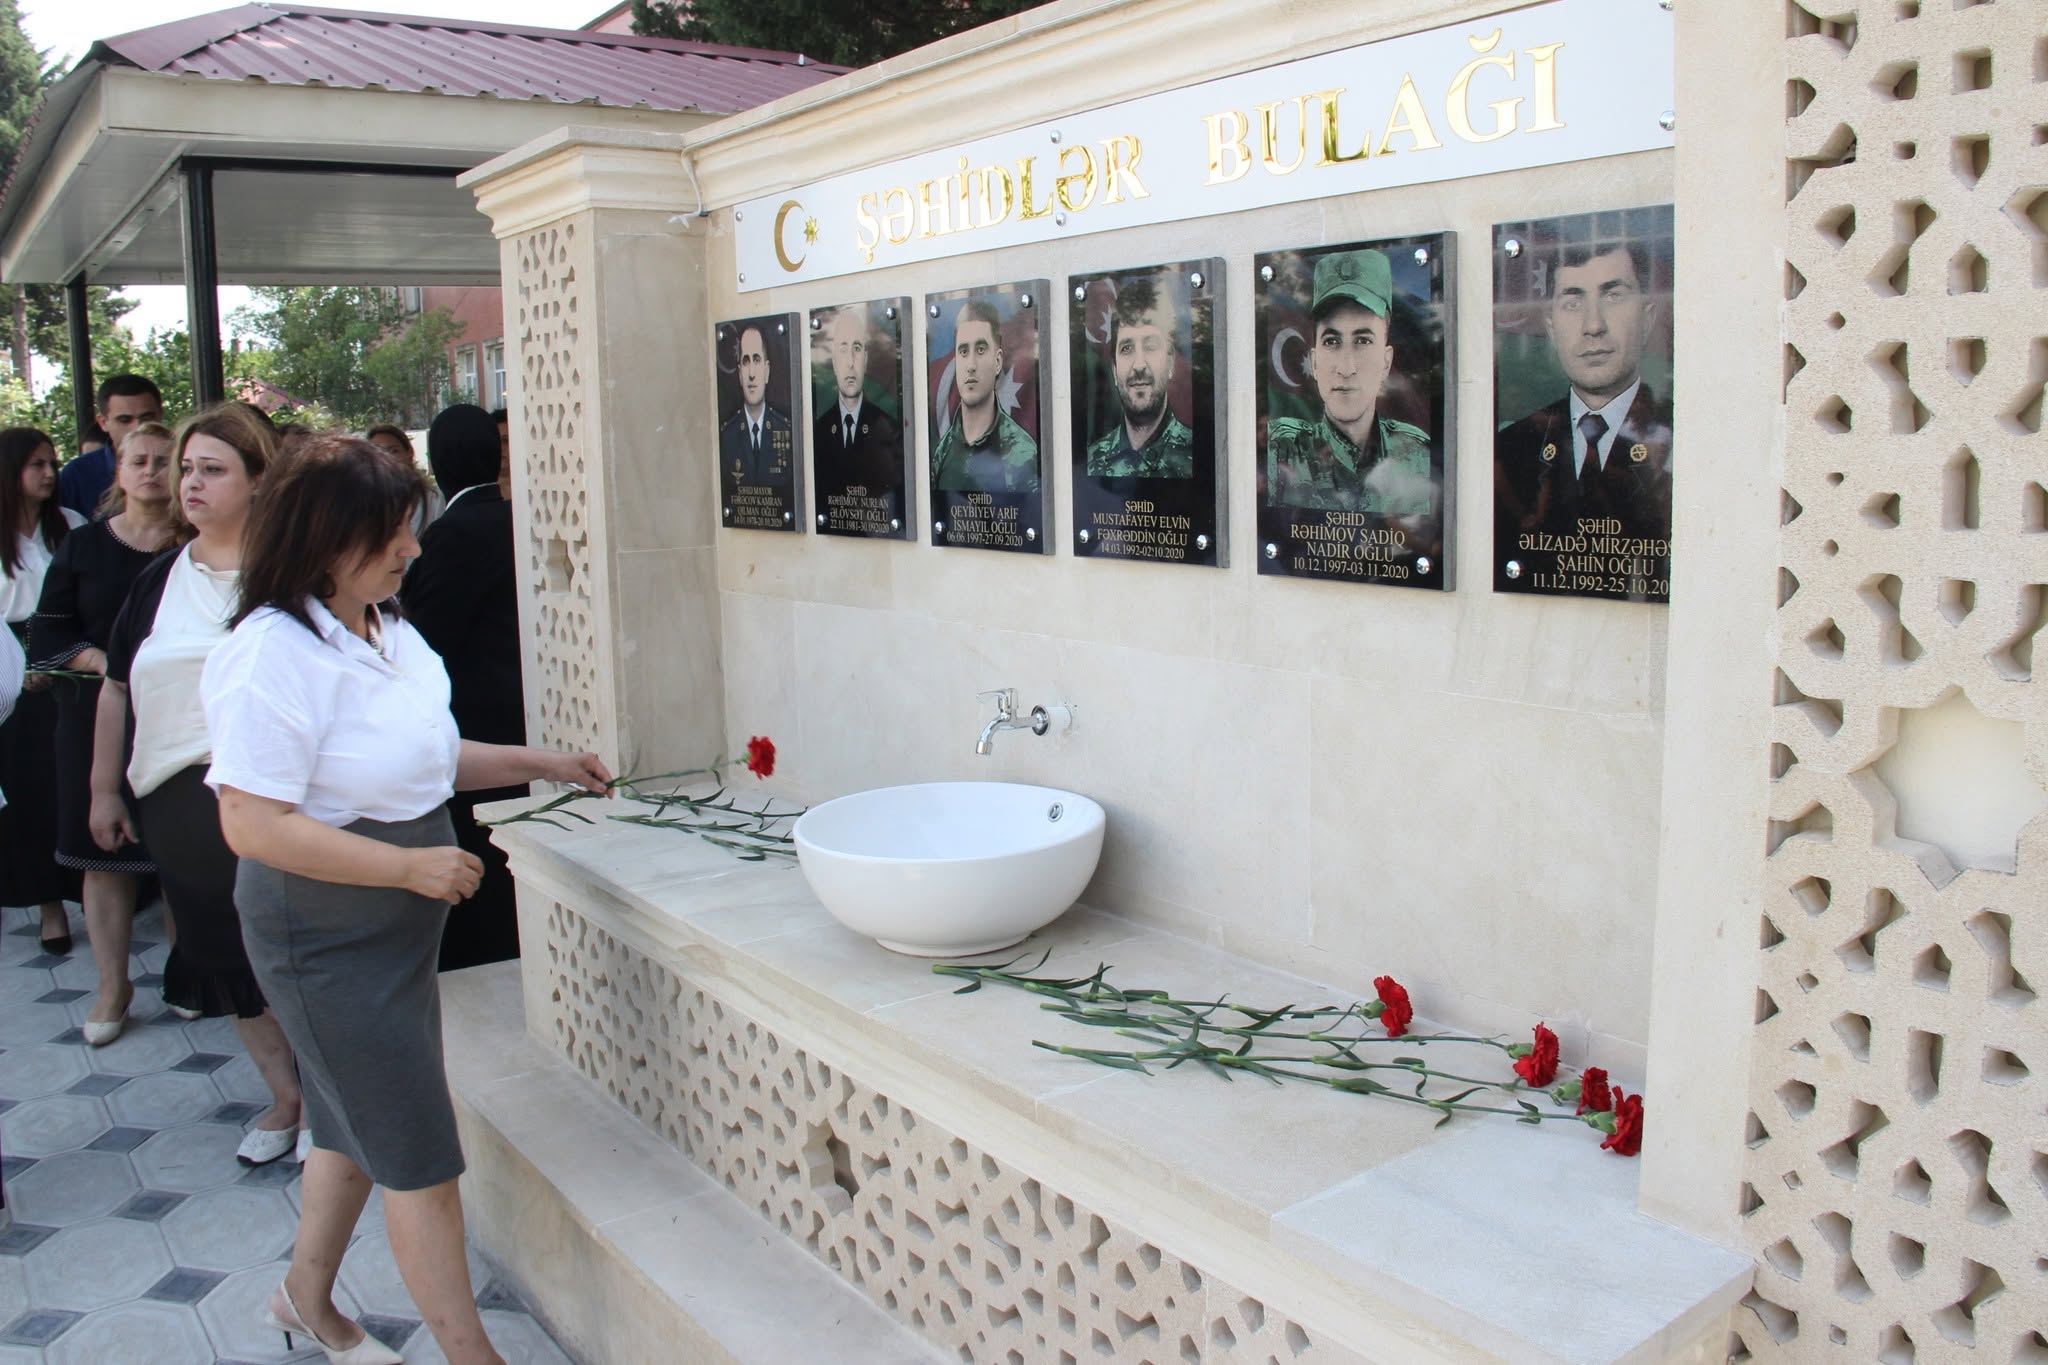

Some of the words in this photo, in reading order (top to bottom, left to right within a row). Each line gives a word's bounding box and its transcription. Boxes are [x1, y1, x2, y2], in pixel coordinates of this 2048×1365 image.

[856, 135, 1151, 265] ŞƏHİDLƏR
[1201, 28, 1567, 187] BULAĞI
[846, 485, 868, 497] ŞƏHİD
[967, 492, 993, 505] ŞƏHİD
[866, 508, 889, 523] OĞLU
[997, 505, 1019, 520] ARİF
[1125, 499, 1155, 514] ŞƏHİD
[990, 519, 1017, 535] OĞLU
[1092, 512, 1158, 528] MUSTAFAYEV
[1159, 514, 1191, 530] ELVİN
[1325, 510, 1365, 527] ŞƏHİD
[1576, 516, 1622, 536] ŞƏHİD
[1097, 528, 1156, 544] FƏXRƏDDİN
[1157, 530, 1188, 547] OĞLU
[1290, 523, 1358, 543] RƏHİMOV
[1360, 527, 1406, 546] SADİQ
[1518, 531, 1587, 553] ƏLİZADƏ
[1306, 540, 1351, 559] NADİR
[1354, 543, 1394, 563] OĞLU
[1293, 556, 1410, 580] 10.12.1997-03.11.2020
[1557, 552, 1605, 576] ŞAHİN
[1608, 554, 1655, 576] OĞLU
